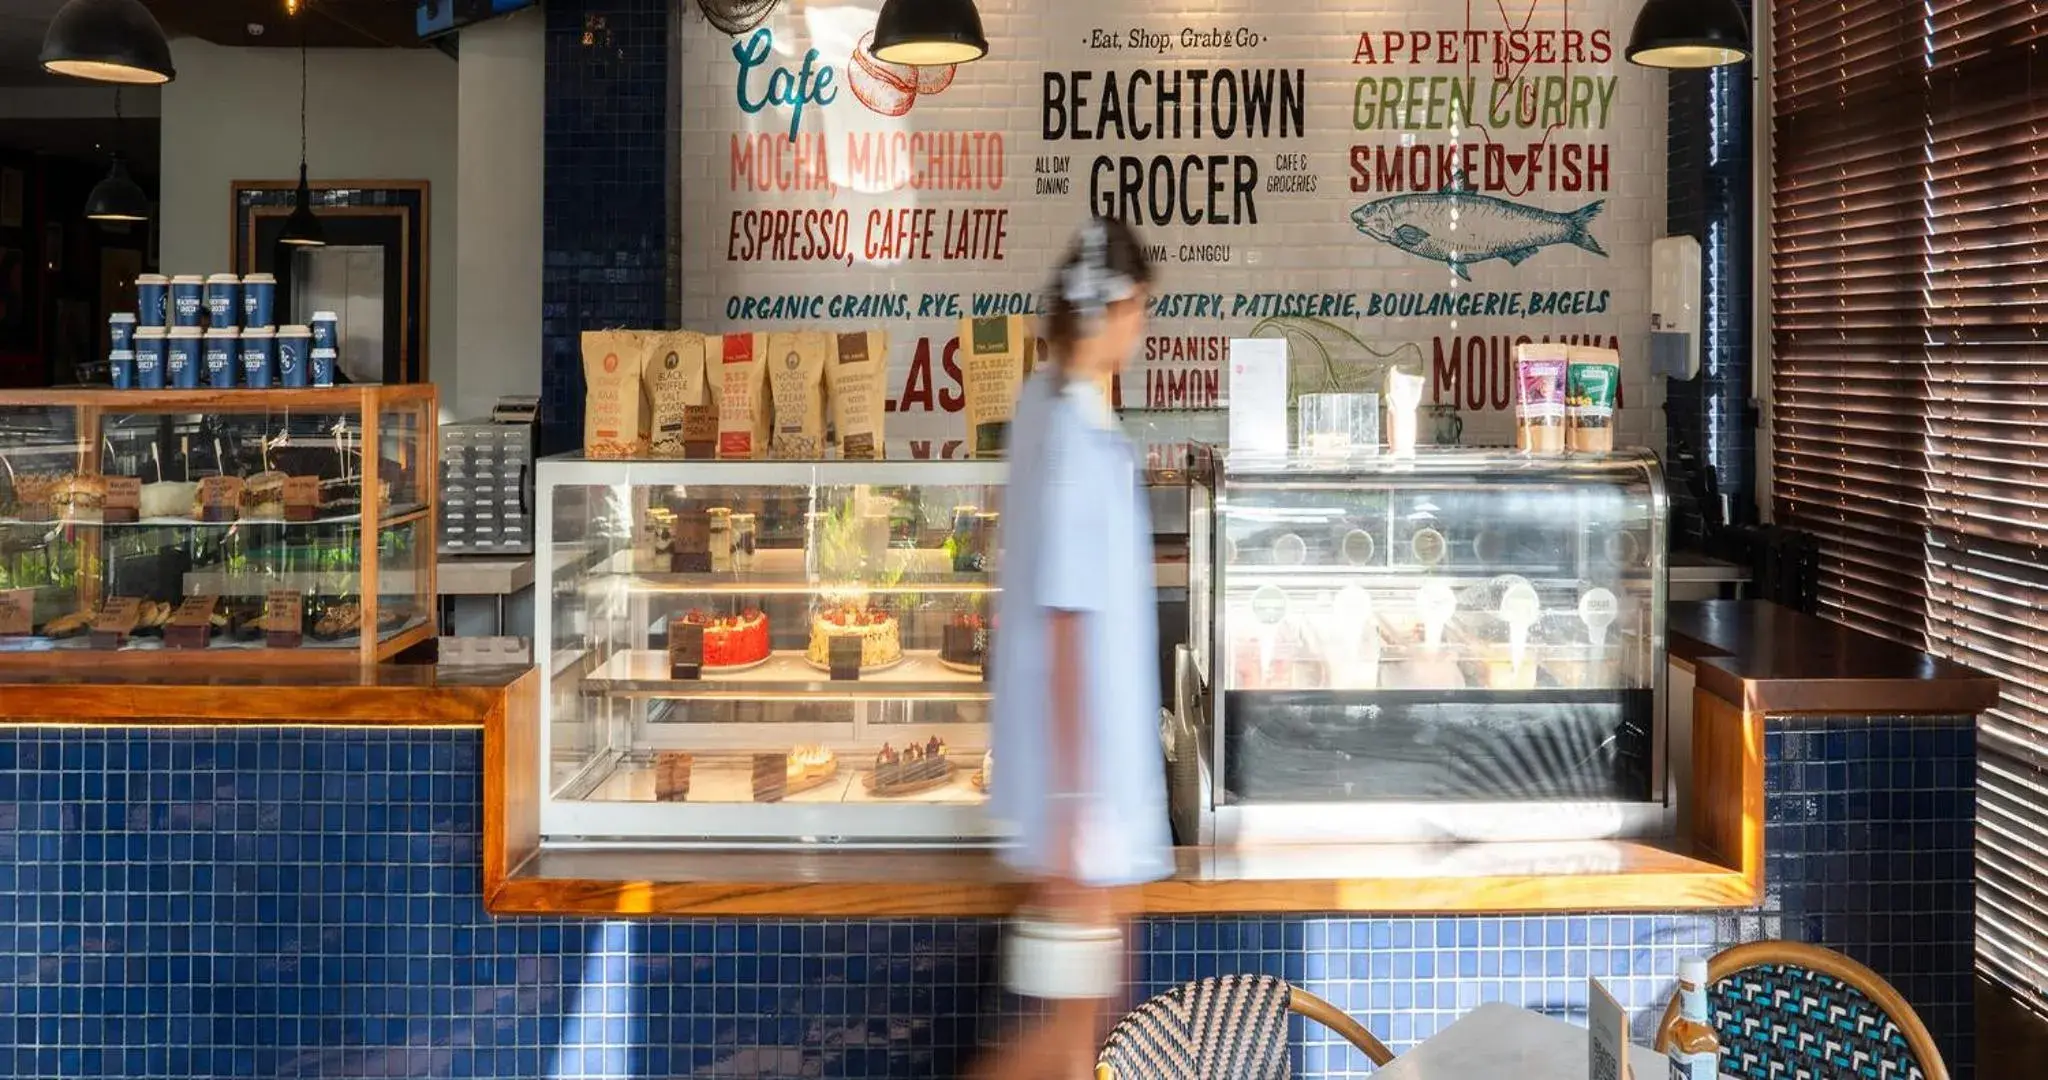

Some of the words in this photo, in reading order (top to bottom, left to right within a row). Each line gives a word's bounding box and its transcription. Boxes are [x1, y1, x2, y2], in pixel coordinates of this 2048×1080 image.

[1128, 28, 1174, 54] Shop,
[1353, 30, 1612, 65] APPETISERS
[1043, 69, 1305, 140] BEACHTOWN
[1352, 76, 1476, 130] GREEN
[1489, 76, 1619, 130] CURRY
[731, 132, 838, 195] MOCHA,
[847, 131, 1004, 191] MACCHIATO
[1035, 156, 1052, 174] ALL
[1054, 156, 1070, 173] DAY
[1350, 144, 1505, 193] SMOKED
[1527, 144, 1609, 192] FISH
[1036, 177, 1069, 195] DINING
[1090, 154, 1259, 226] GROCER
[1266, 174, 1318, 193] GROCERIES
[727, 210, 854, 268] ESPRESSO,
[864, 210, 936, 261] CAFFE
[943, 209, 1007, 261] LATTE
[1179, 244, 1230, 262] CANGGU
[726, 296, 823, 320] ORGANIC
[829, 293, 909, 320] GRAINS,
[917, 293, 963, 320] RYE,
[1231, 293, 1361, 319] PATISSERIE,
[1145, 336, 1230, 361] SPANISH
